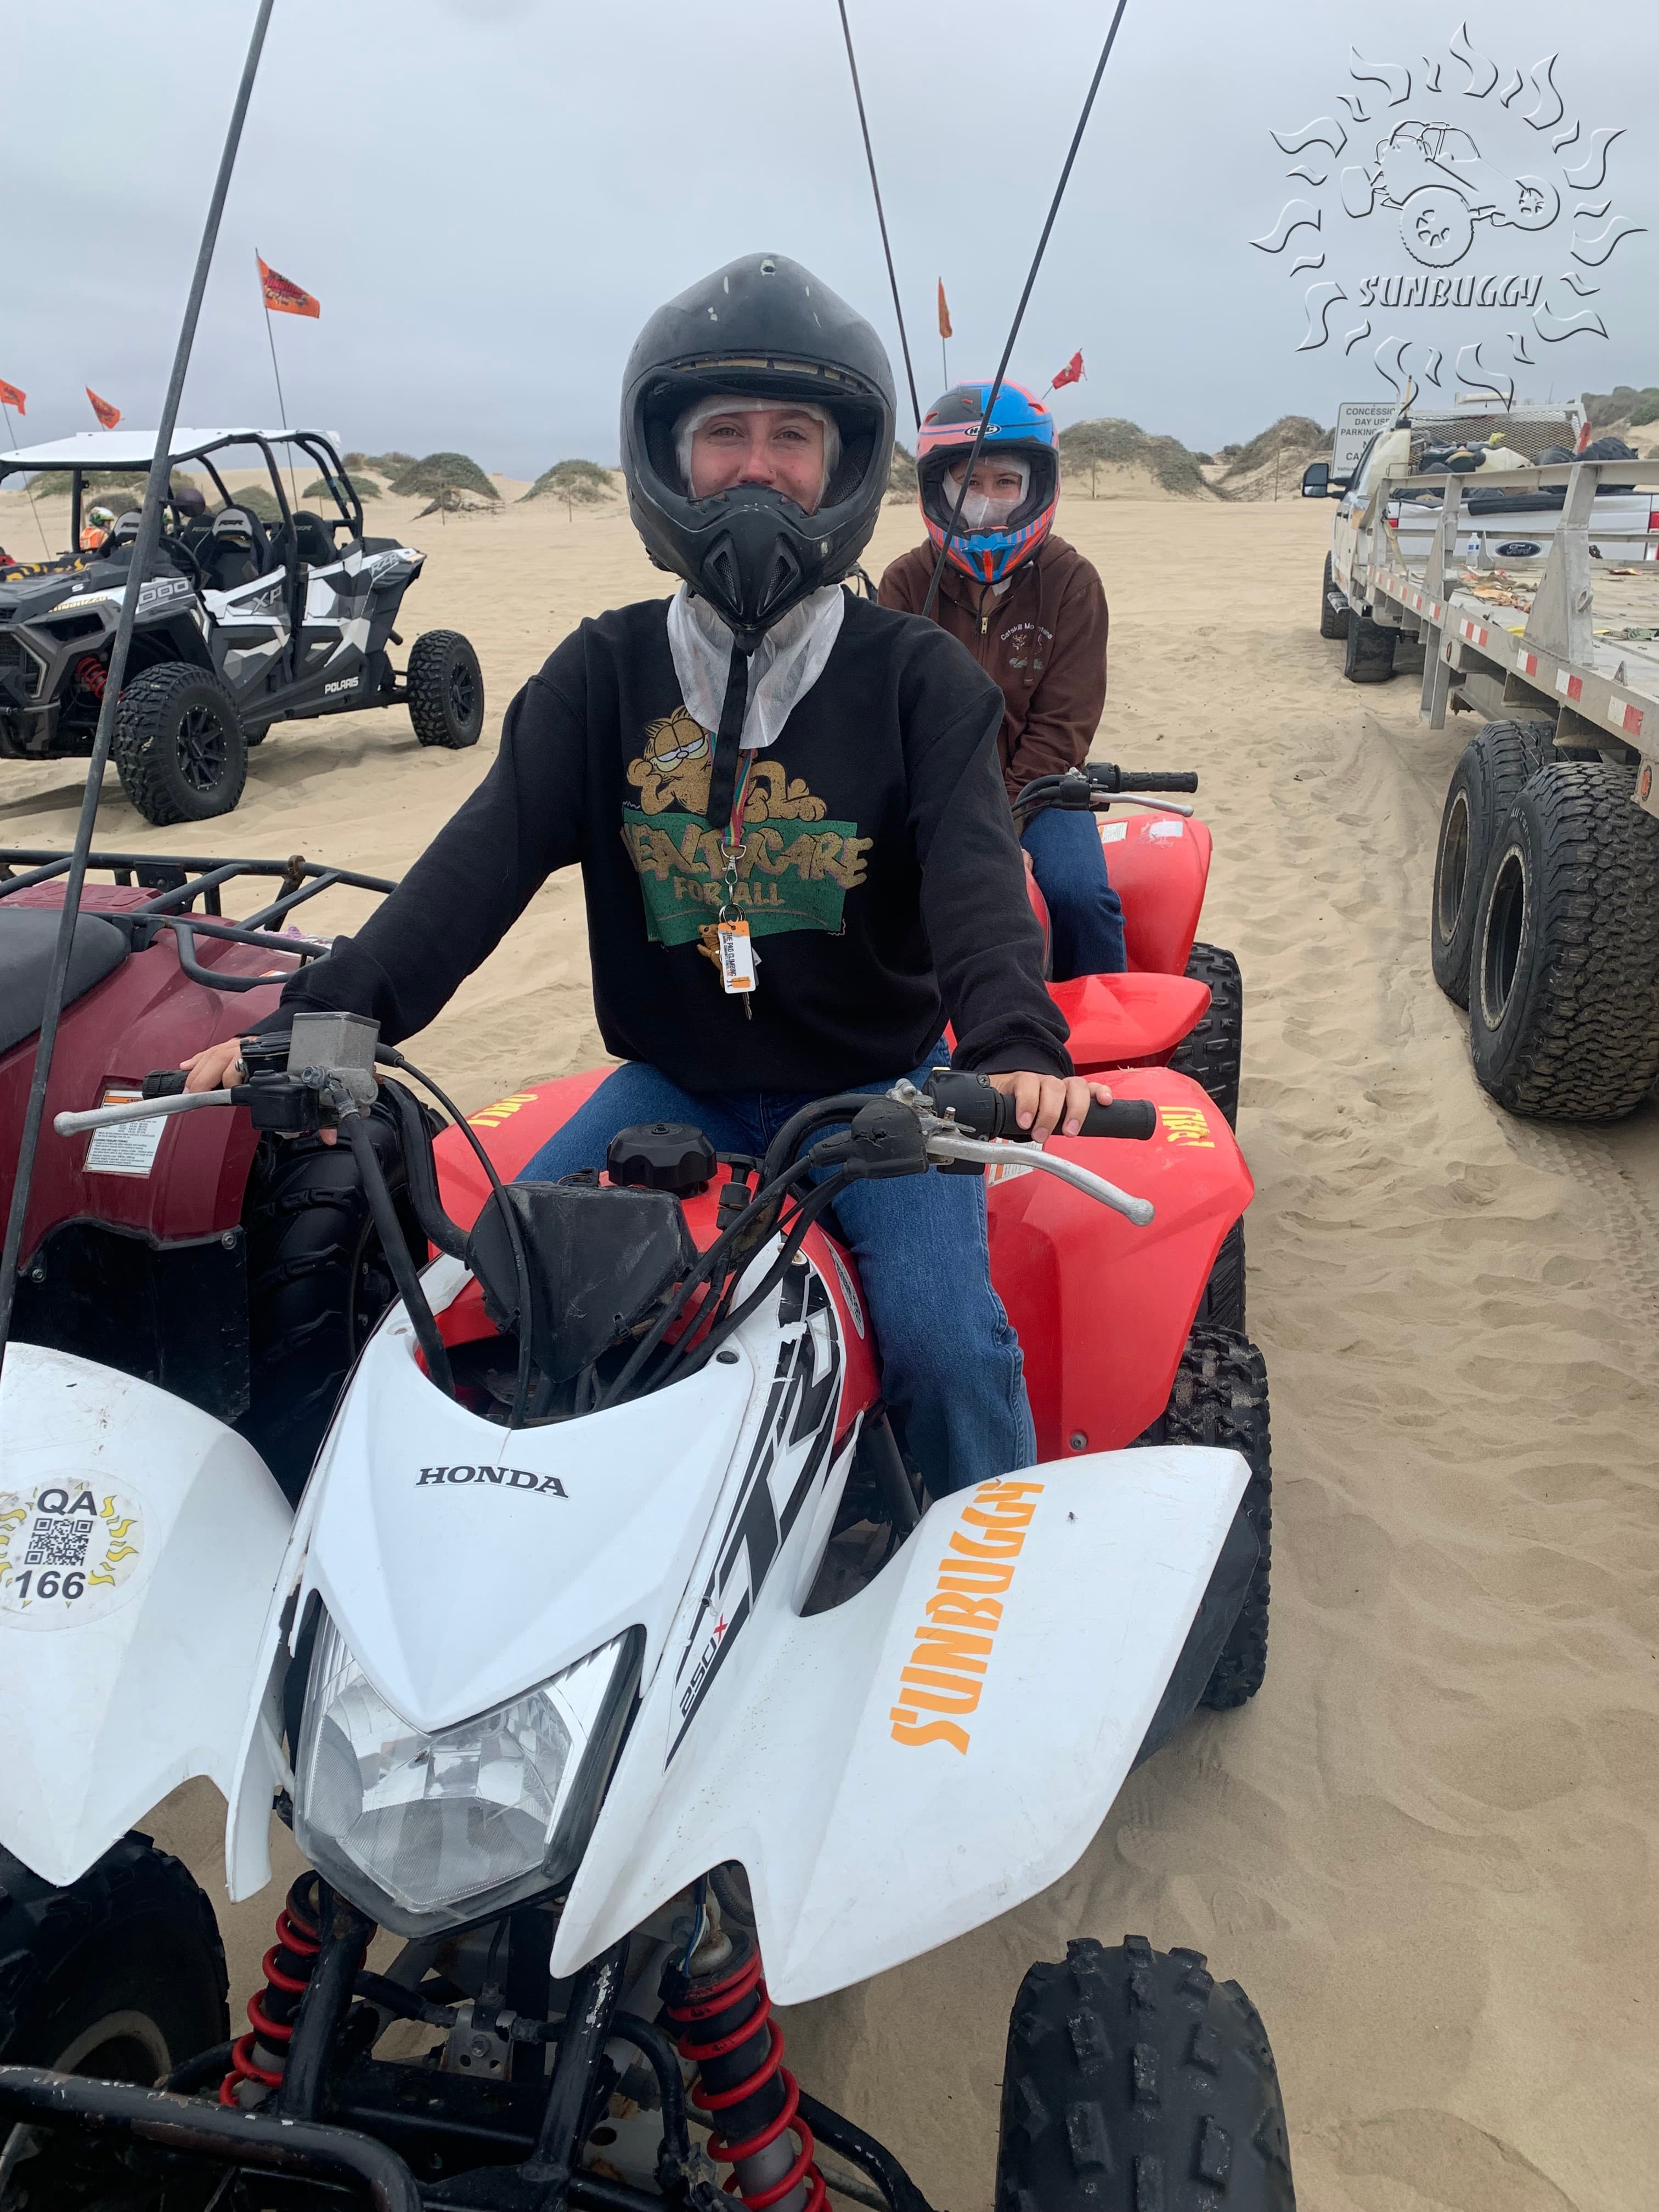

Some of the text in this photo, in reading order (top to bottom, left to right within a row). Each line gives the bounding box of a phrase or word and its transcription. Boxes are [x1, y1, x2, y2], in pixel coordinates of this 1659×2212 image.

[969, 426, 995, 435] HC
[1506, 544, 1532, 555] Ford
[252, 585, 282, 613] XP
[325, 676, 359, 695] POLARIS
[673, 876, 786, 906] FOR ALL
[728, 953, 737, 977] CLIMBING
[415, 1466, 569, 1499] HONDA
[37, 1488, 98, 1516] QA
[15, 1570, 86, 1599] 166
[889, 1478, 1045, 1756] SUNBUGGY
[679, 1612, 729, 1718] 250X
